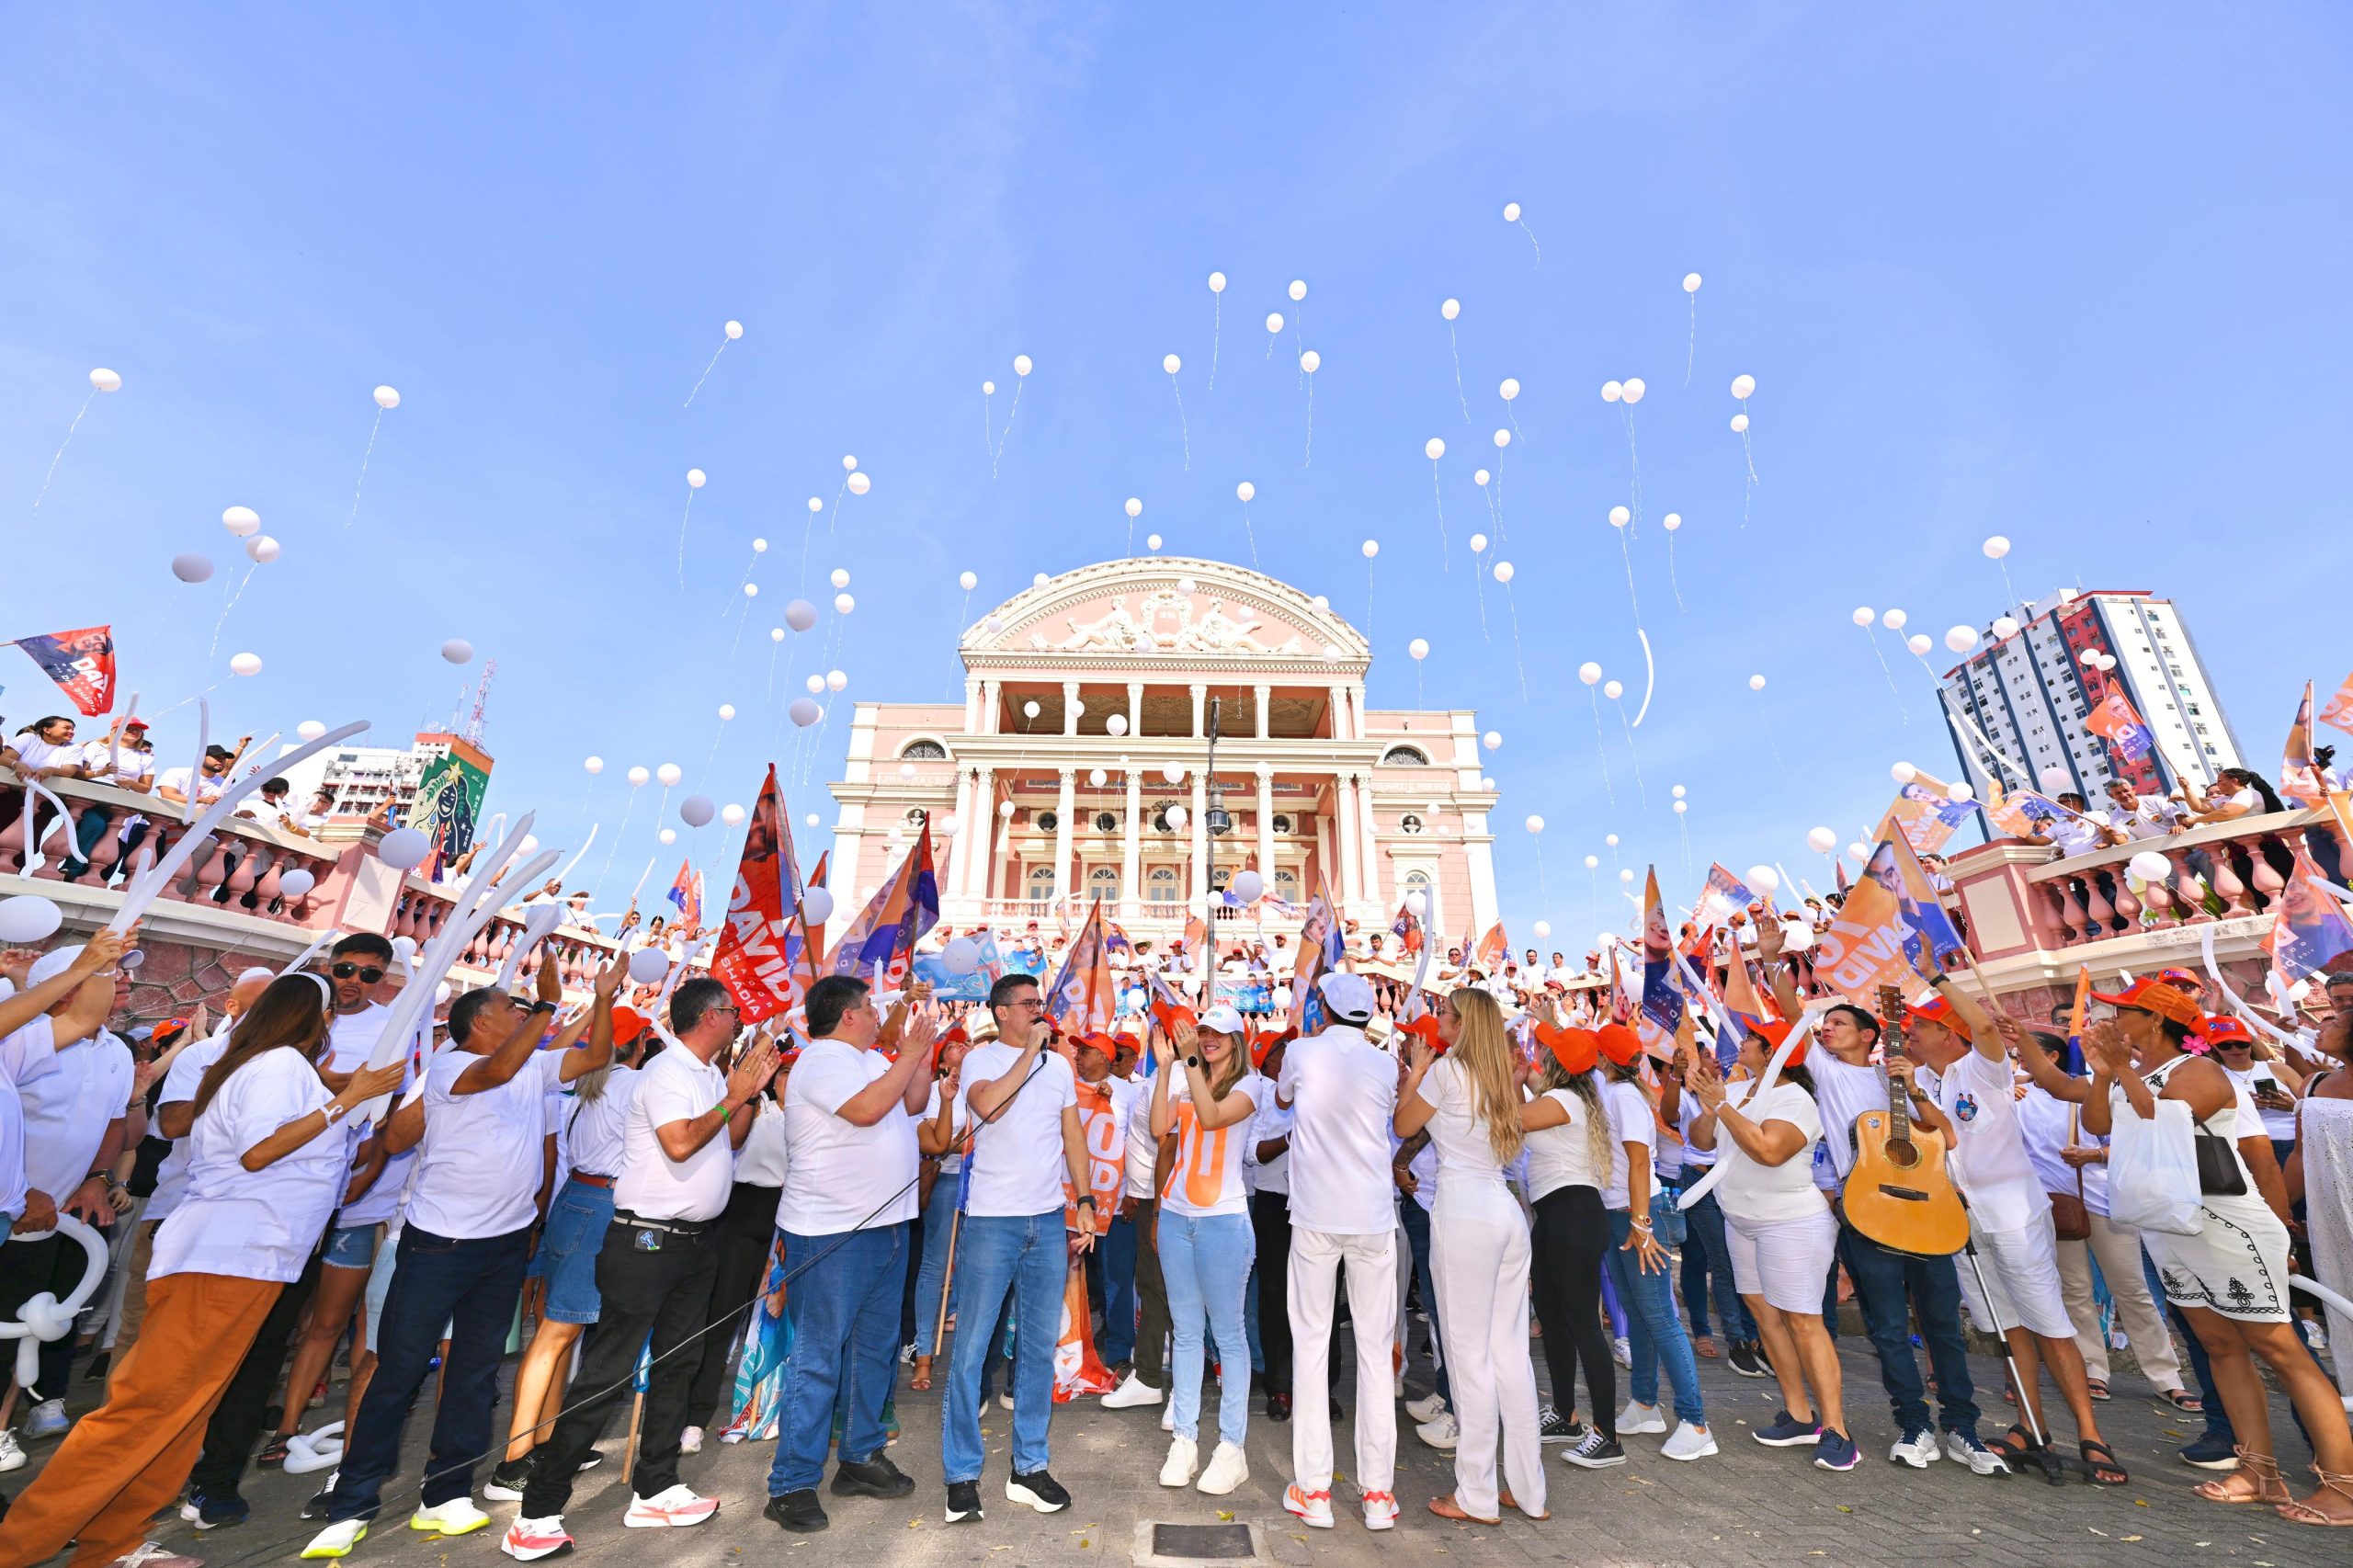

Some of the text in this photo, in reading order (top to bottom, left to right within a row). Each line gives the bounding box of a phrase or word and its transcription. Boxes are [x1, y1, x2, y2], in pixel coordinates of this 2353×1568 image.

[727, 871, 792, 1002] DAVID
[721, 956, 761, 1017] SHÁDIA
[1650, 994, 1667, 1007] VICE
